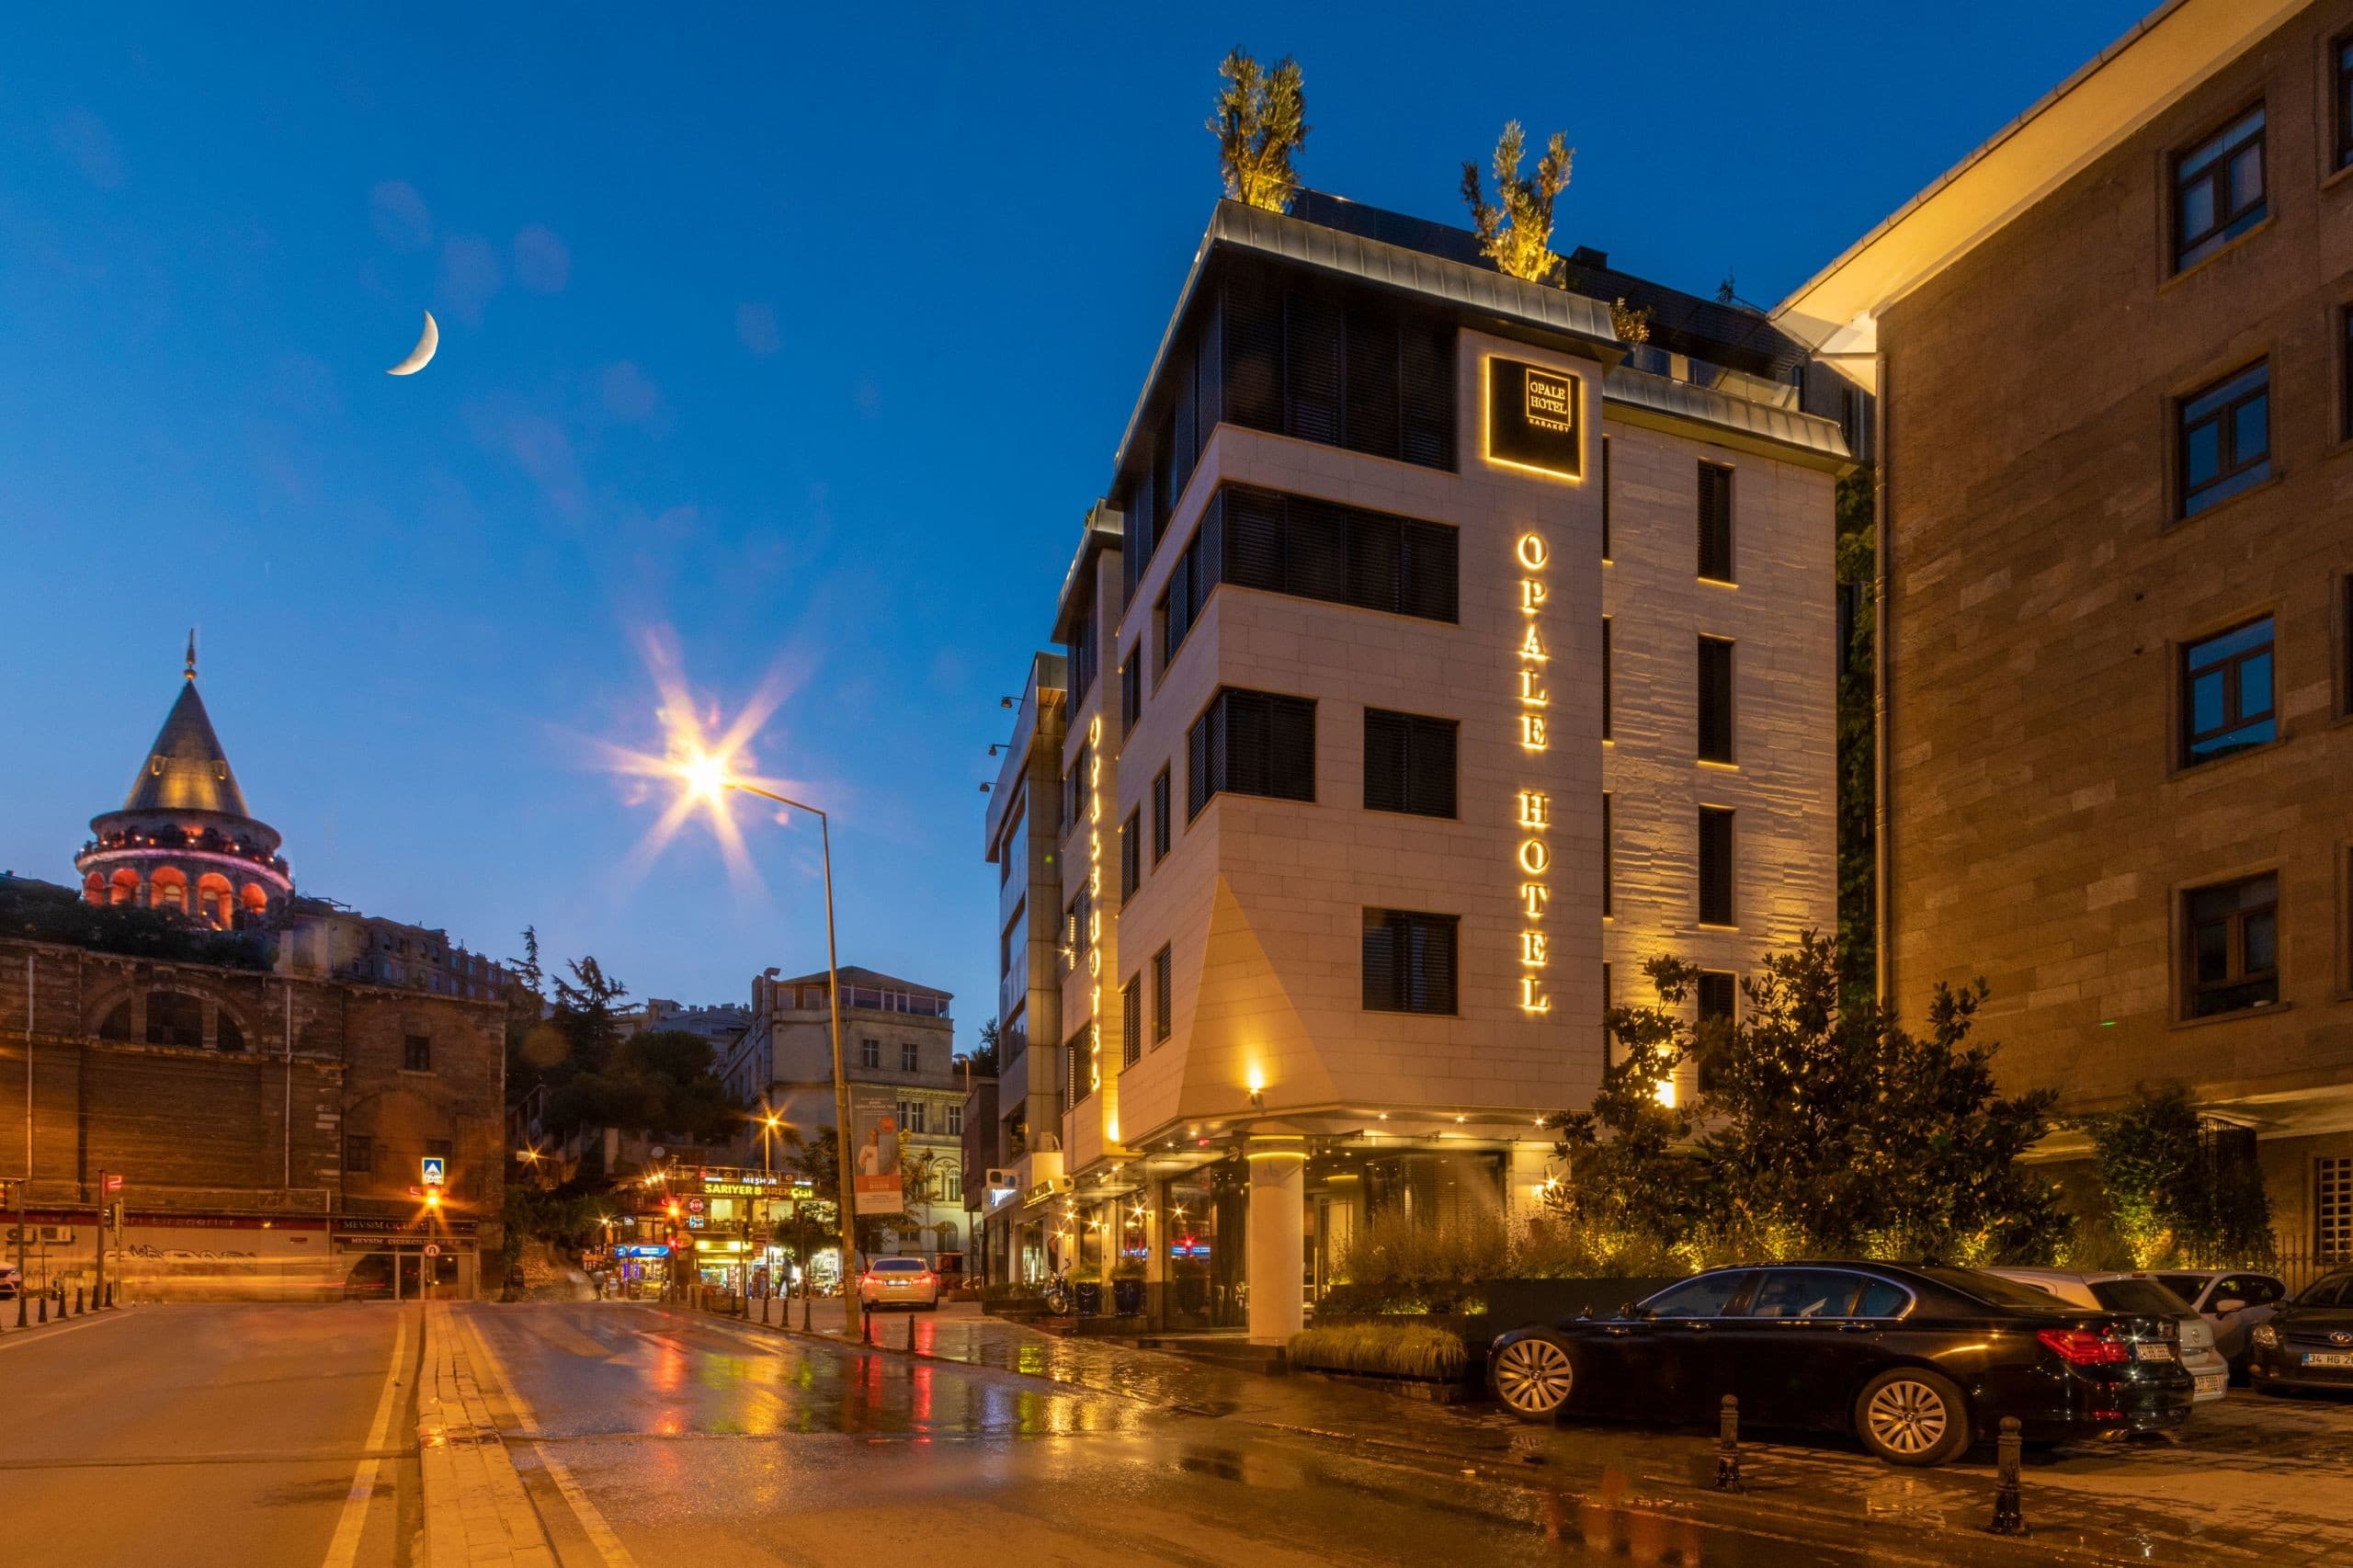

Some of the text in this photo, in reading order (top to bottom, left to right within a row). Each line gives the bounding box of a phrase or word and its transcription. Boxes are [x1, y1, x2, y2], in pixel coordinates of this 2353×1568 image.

[1529, 381, 1566, 400] OPALE
[1530, 395, 1567, 415] HOTEL
[1518, 532, 1550, 1012] OPALE HOTEL
[2309, 1355, 2322, 1363] 34
